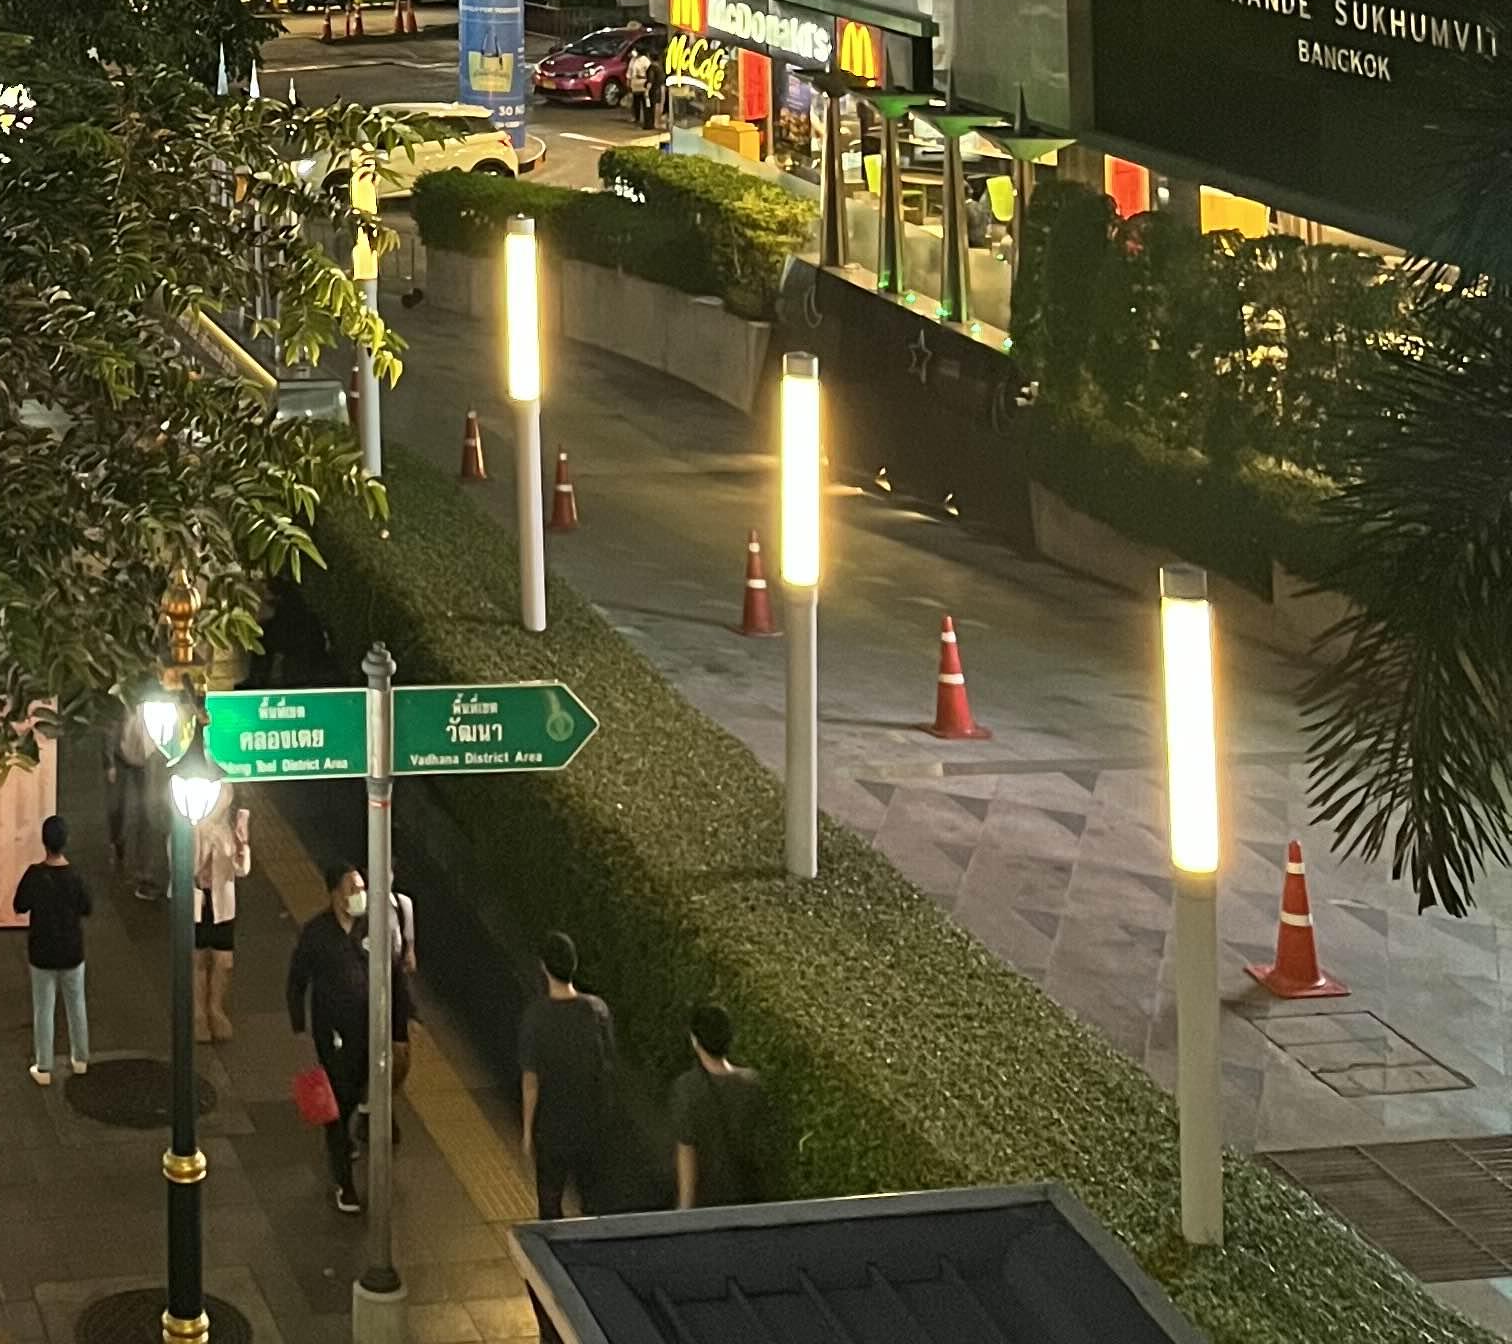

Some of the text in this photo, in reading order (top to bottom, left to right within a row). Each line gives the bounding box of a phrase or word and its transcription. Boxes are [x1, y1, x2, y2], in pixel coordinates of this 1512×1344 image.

[1298, 39, 1392, 82] BANGKOK
[239, 728, 325, 752] คลองเตย
[281, 758, 320, 772] District
[324, 757, 348, 770] Area
[410, 751, 543, 766] Vadhana District Area
